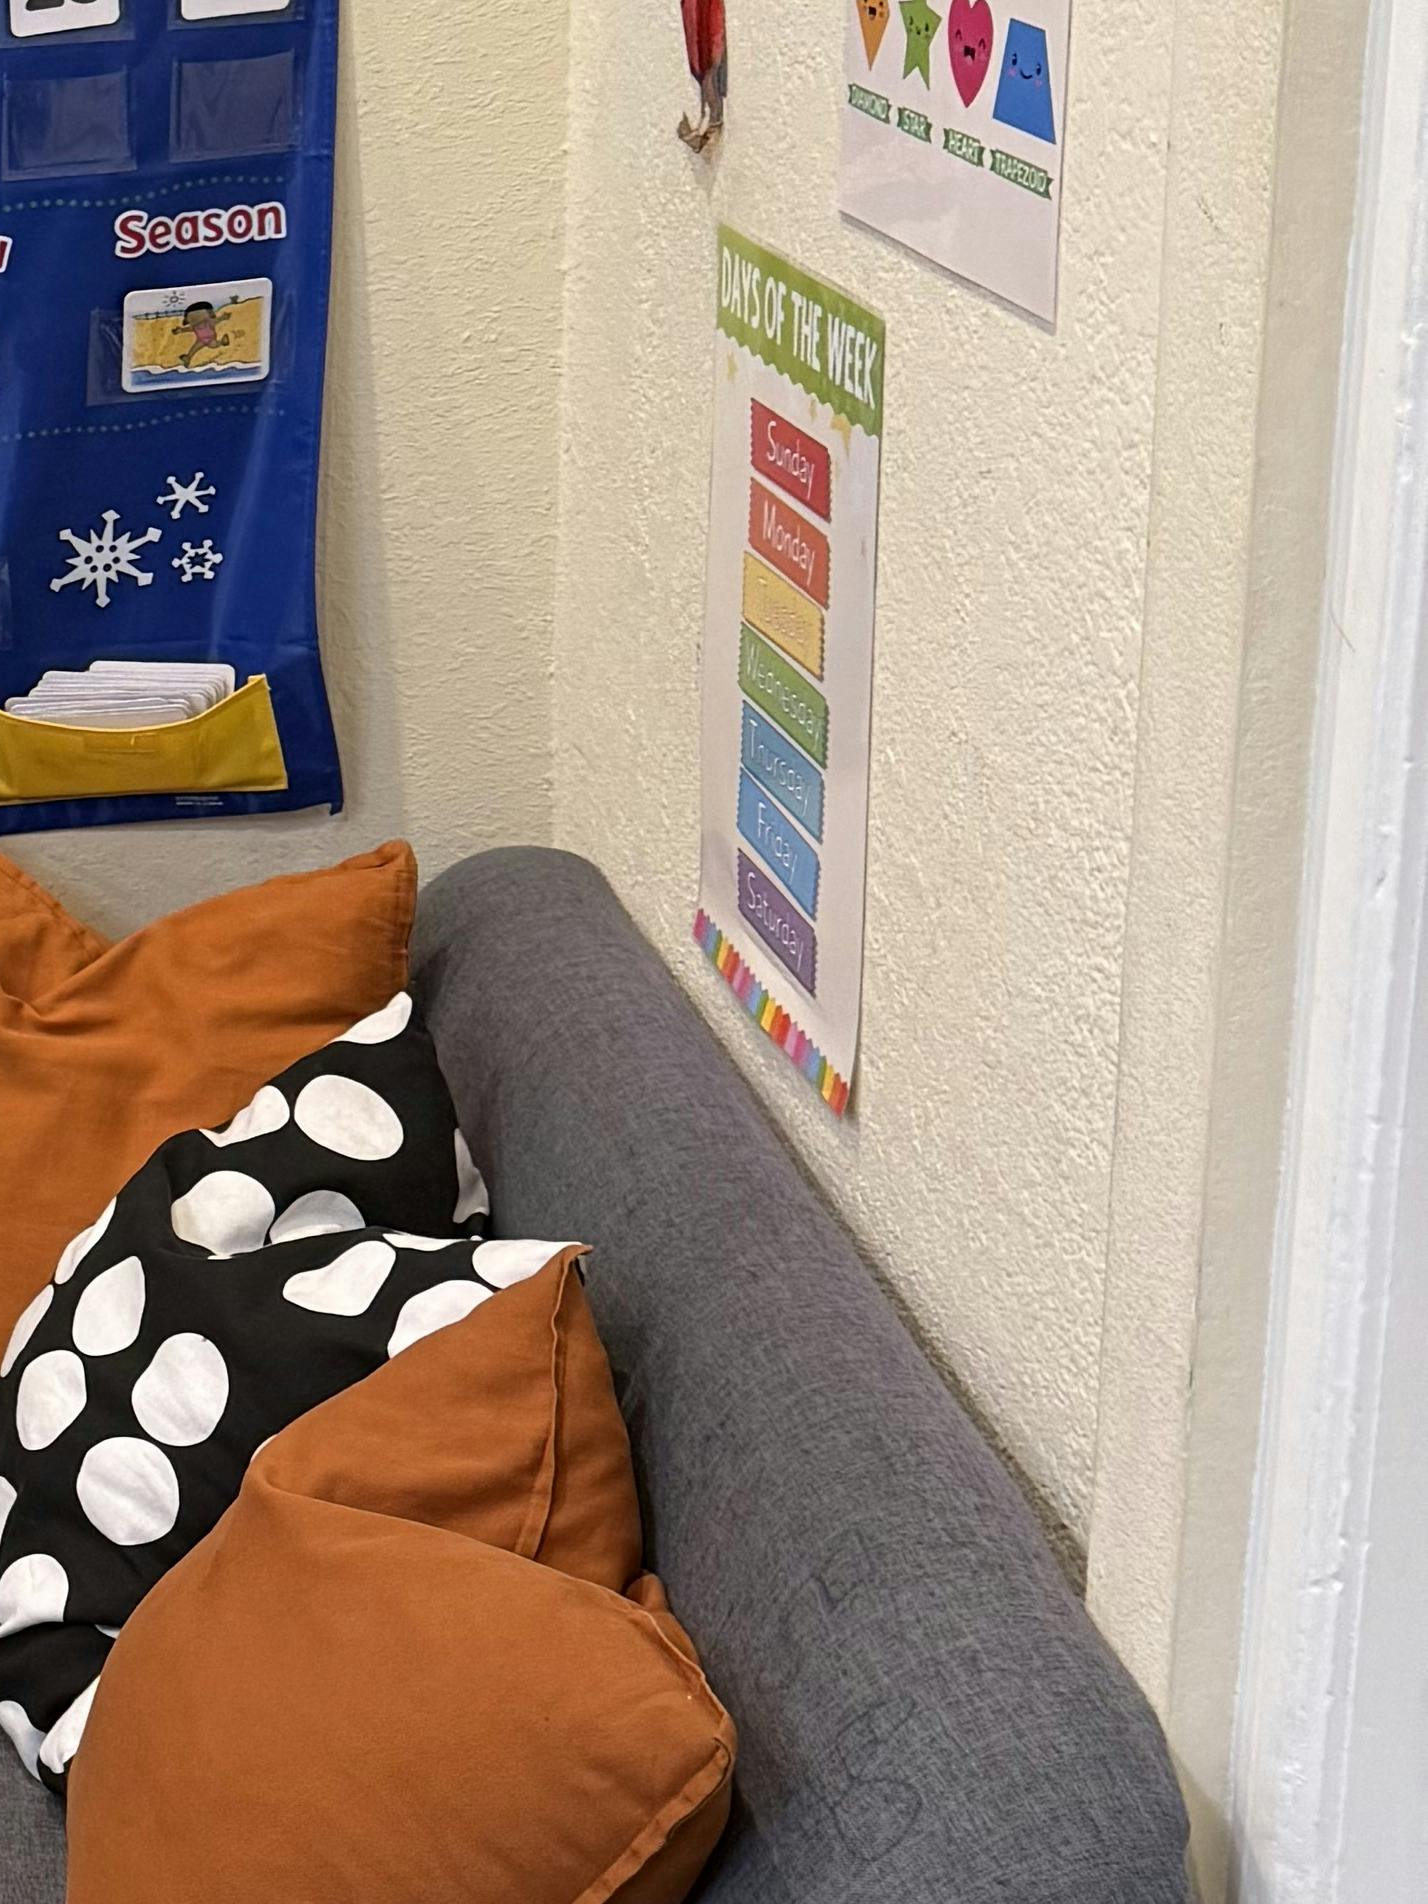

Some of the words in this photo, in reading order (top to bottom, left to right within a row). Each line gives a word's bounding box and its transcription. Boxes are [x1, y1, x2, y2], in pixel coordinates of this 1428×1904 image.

[115, 201, 286, 257] Season
[721, 246, 761, 329] DAYS
[765, 276, 786, 345] OF
[792, 290, 822, 372] THE
[828, 313, 877, 410] WEEK
[766, 421, 815, 500] Sunday
[763, 500, 815, 585] Monday
